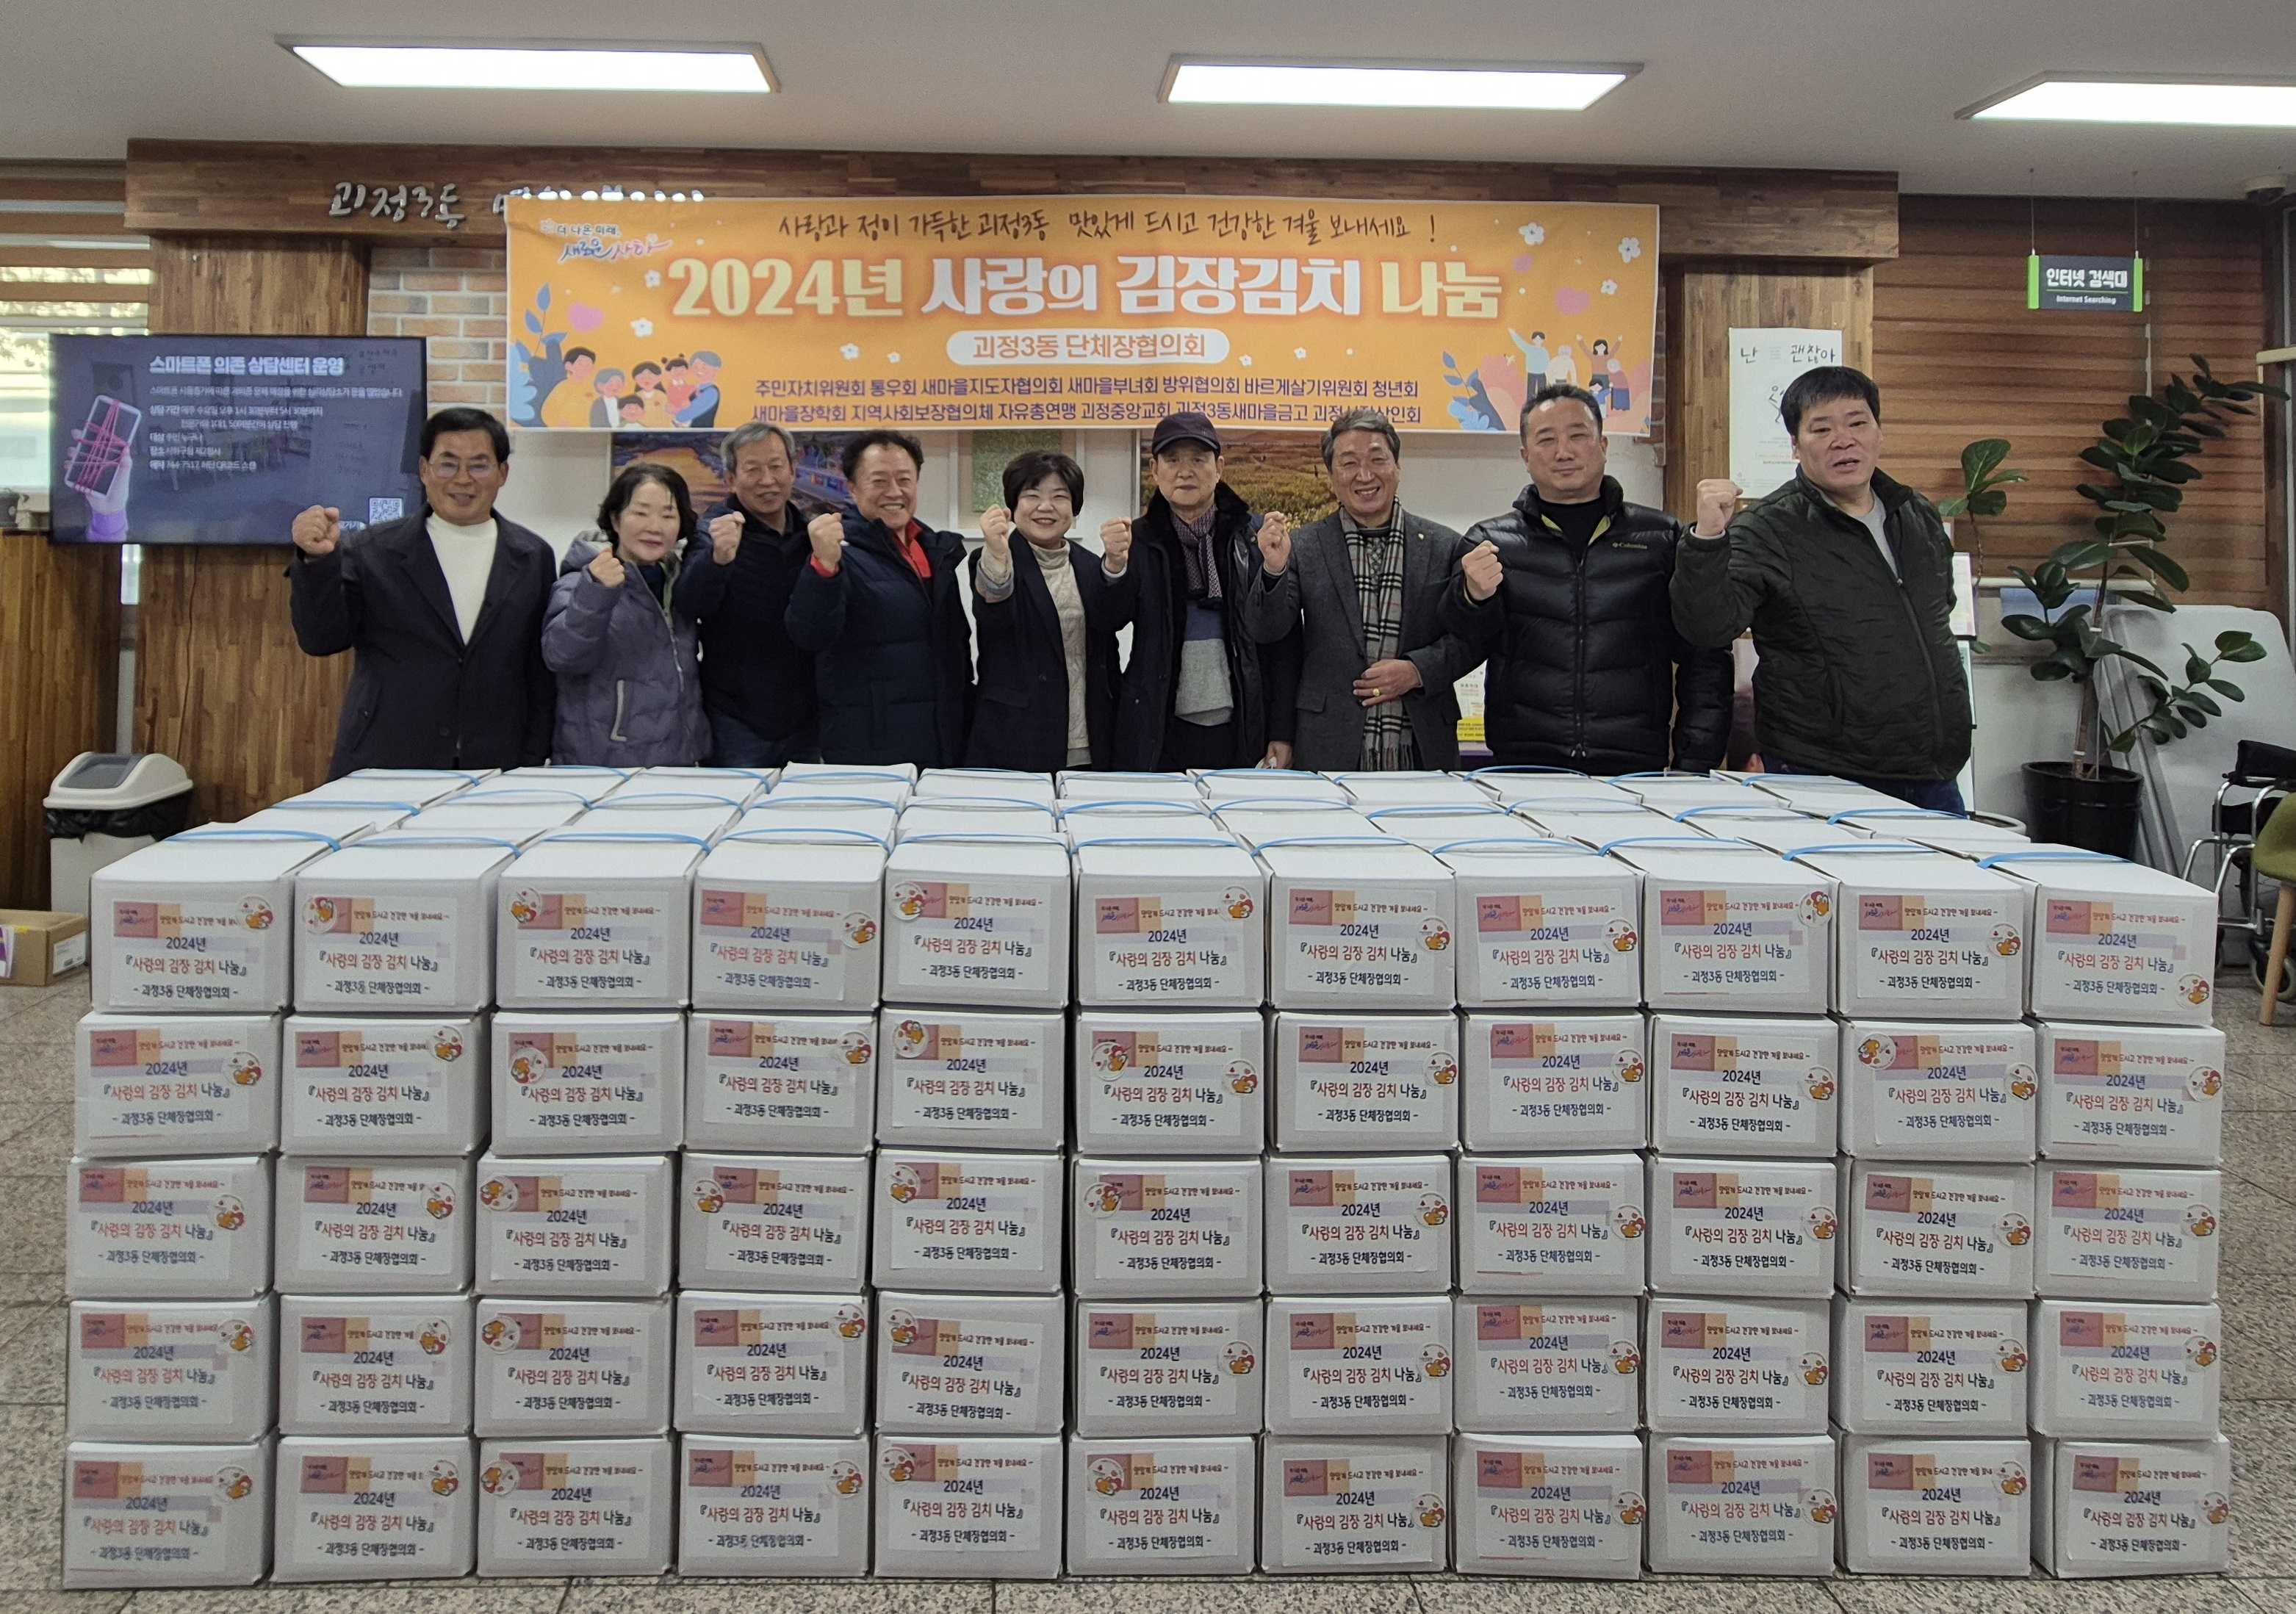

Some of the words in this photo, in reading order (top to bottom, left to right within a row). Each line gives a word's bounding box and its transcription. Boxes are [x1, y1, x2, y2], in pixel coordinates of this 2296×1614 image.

[329, 181, 464, 229] 괴정3동
[557, 226, 566, 235] 더
[571, 225, 591, 236] 나은
[779, 214, 848, 242] 사랑과
[858, 214, 899, 241] 정이
[909, 210, 972, 242] 가득한
[977, 209, 1049, 241] 괴정3동
[1069, 211, 1134, 239] 맛있게
[1145, 210, 1198, 234] 드시고
[1208, 210, 1275, 241] 건강한
[1283, 209, 1322, 246] 겨울
[1330, 215, 1410, 239] 보내세요
[561, 238, 613, 262] 새로운
[612, 240, 672, 261] 사하
[2046, 267, 2085, 287] 인터넷
[2089, 270, 2128, 289] 검색대
[669, 258, 903, 317] 2024년
[921, 258, 1097, 316] 사랑의
[1117, 256, 1360, 316] 김장김치
[1381, 261, 1502, 318] 나눔
[2056, 295, 2084, 303] Internet
[2084, 295, 2117, 305] Searching
[972, 336, 1059, 359] 괴정3동
[1065, 333, 1206, 359] 단체장협의회
[1740, 346, 1758, 364] 난
[1791, 343, 1835, 364] 괜찮아
[150, 356, 212, 375] 스마트폰
[214, 356, 245, 375] 의존
[248, 356, 310, 375] 상담센터
[313, 356, 345, 375] 운영
[755, 379, 866, 397] 주민자치위원회
[870, 379, 916, 397] 통우회
[921, 377, 1062, 396] 새마을지도자협의회
[1068, 377, 1158, 395] 새마을부녀회
[1163, 375, 1239, 395] 방위협의회
[1245, 378, 1367, 397] 바르게살기위원회
[1372, 379, 1418, 398] 청년회
[150, 405, 164, 417] 상담
[752, 405, 846, 422] 새마을장학회
[852, 403, 993, 422] 지역사회보장협의체
[998, 403, 1076, 421] 자유총연맹
[1081, 401, 1170, 420] 괴정중앙교회
[1340, 924, 1378, 939] 2024년
[359, 932, 399, 947] 2024년
[1343, 946, 1362, 960] 김장
[1367, 946, 1387, 961] 김치
[361, 954, 382, 970] 김장
[386, 955, 406, 970] 김치
[1316, 972, 1347, 984] 괴정3동
[1350, 973, 1400, 985] 단체장협의회
[334, 980, 365, 993] 괴정3동
[368, 981, 421, 994] 단체장협의회
[145, 1062, 187, 1076] 2024년
[947, 1059, 987, 1073] 2024년
[149, 1084, 170, 1100] 김장
[176, 1084, 197, 1099] 김치
[949, 1081, 970, 1095] 김장
[974, 1081, 994, 1095] 김치
[121, 1112, 154, 1125] 괴정3동
[156, 1110, 213, 1124] 단체장협의회
[923, 1107, 954, 1120] 괴정3동
[957, 1107, 1009, 1120] 단체장협의회
[547, 1210, 587, 1225] 2024년
[1725, 1206, 1763, 1221] 2024년
[550, 1232, 570, 1247] 김장
[575, 1232, 595, 1247] 김치
[1727, 1228, 1748, 1243] 김장
[1752, 1228, 1771, 1243] 김치
[522, 1258, 553, 1271] 괴정3동
[557, 1259, 610, 1272] 단체장협의회
[1701, 1255, 1732, 1268] 괴정3동
[1735, 1255, 1786, 1268] 단체장협의회
[1917, 1351, 1955, 1365] 2024년
[1920, 1372, 1940, 1387] 김장
[1944, 1372, 1964, 1387] 김치
[1894, 1399, 1924, 1412] 괴정3동
[1928, 1399, 1979, 1412] 단체장협의회
[1140, 1486, 1178, 1501] 2024년
[1531, 1487, 1570, 1501] 2024년
[1143, 1509, 1164, 1524] 김장
[1168, 1509, 1187, 1524] 김치
[1534, 1508, 1555, 1524] 김장
[1559, 1509, 1579, 1524] 김치
[1117, 1538, 1148, 1549] 괴정3동
[1151, 1535, 1203, 1549] 단체장협의회
[1508, 1535, 1539, 1548] 괴정3동
[1543, 1535, 1595, 1548] 단체장협의회
